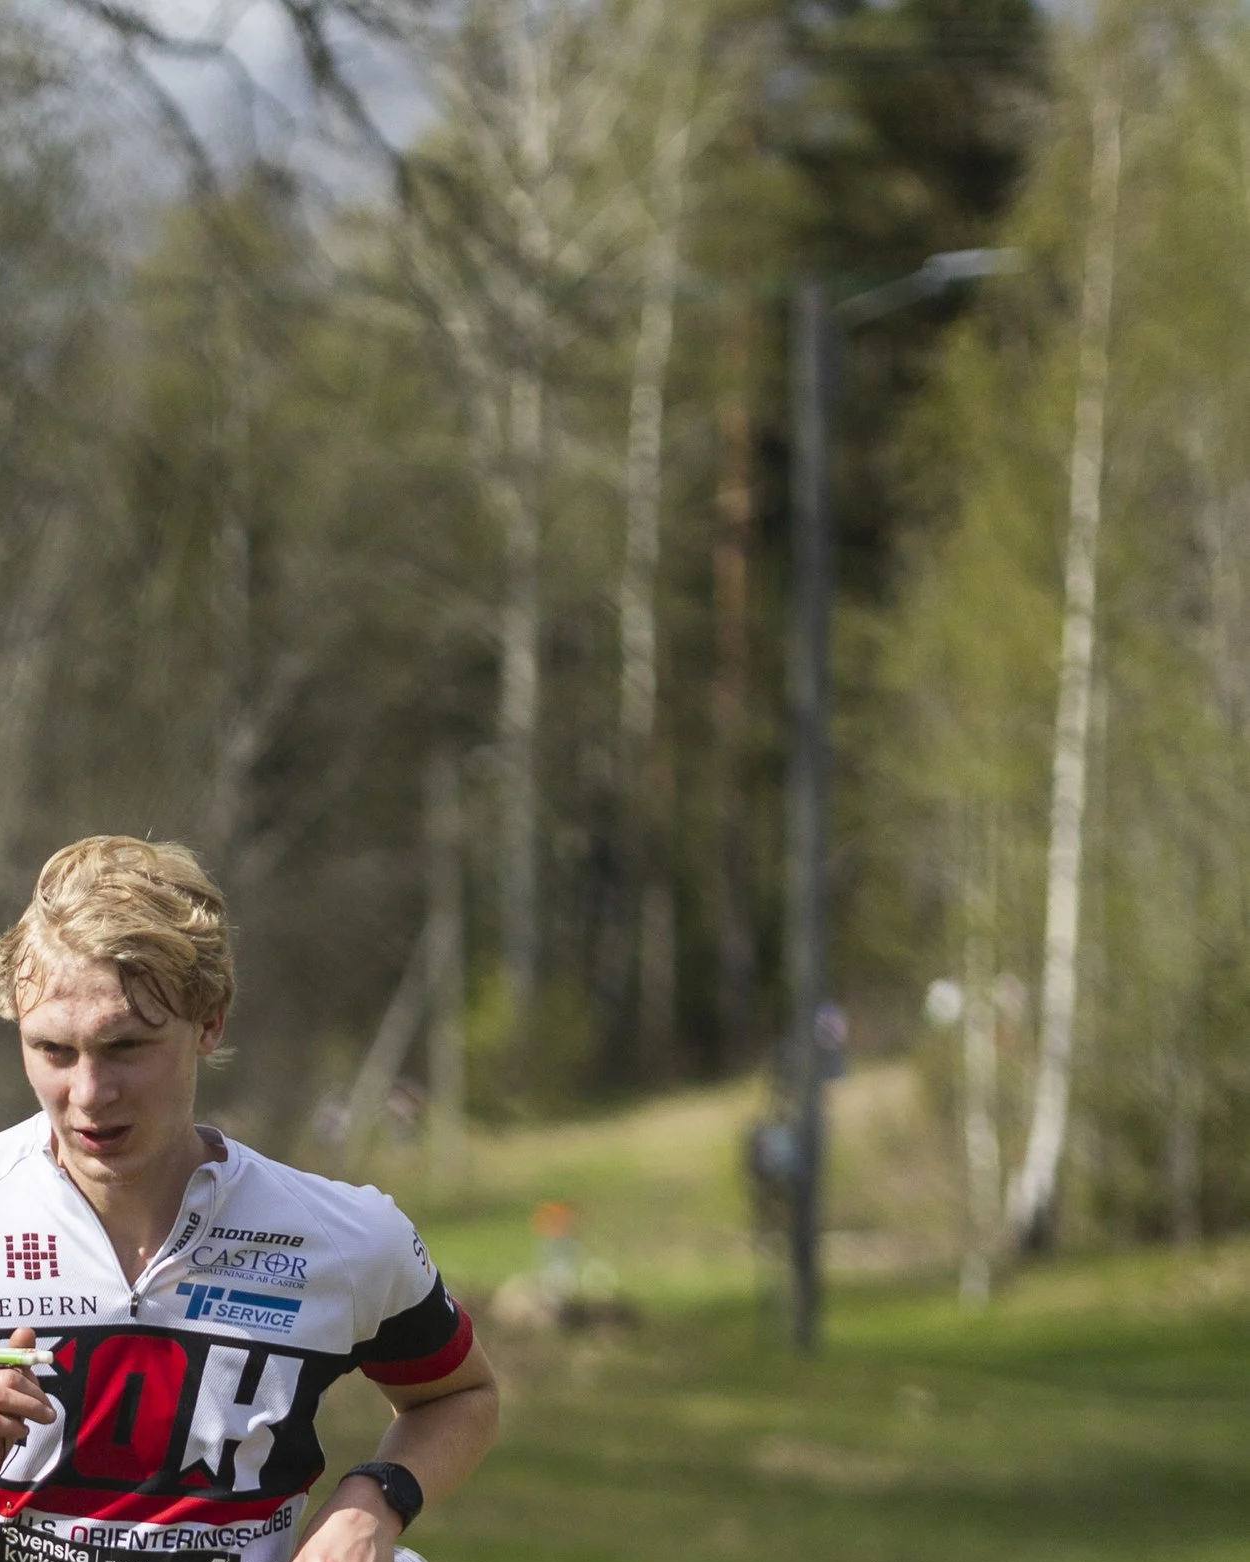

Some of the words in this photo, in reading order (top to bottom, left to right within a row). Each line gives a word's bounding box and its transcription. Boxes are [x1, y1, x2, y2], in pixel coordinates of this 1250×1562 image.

[209, 1227, 304, 1248] noname
[191, 1245, 308, 1280] CASTOR
[271, 1279, 305, 1290] CASTOR
[216, 1303, 296, 1328] SERVICE
[71, 1506, 292, 1550] ORIENTERINGSLUBB
